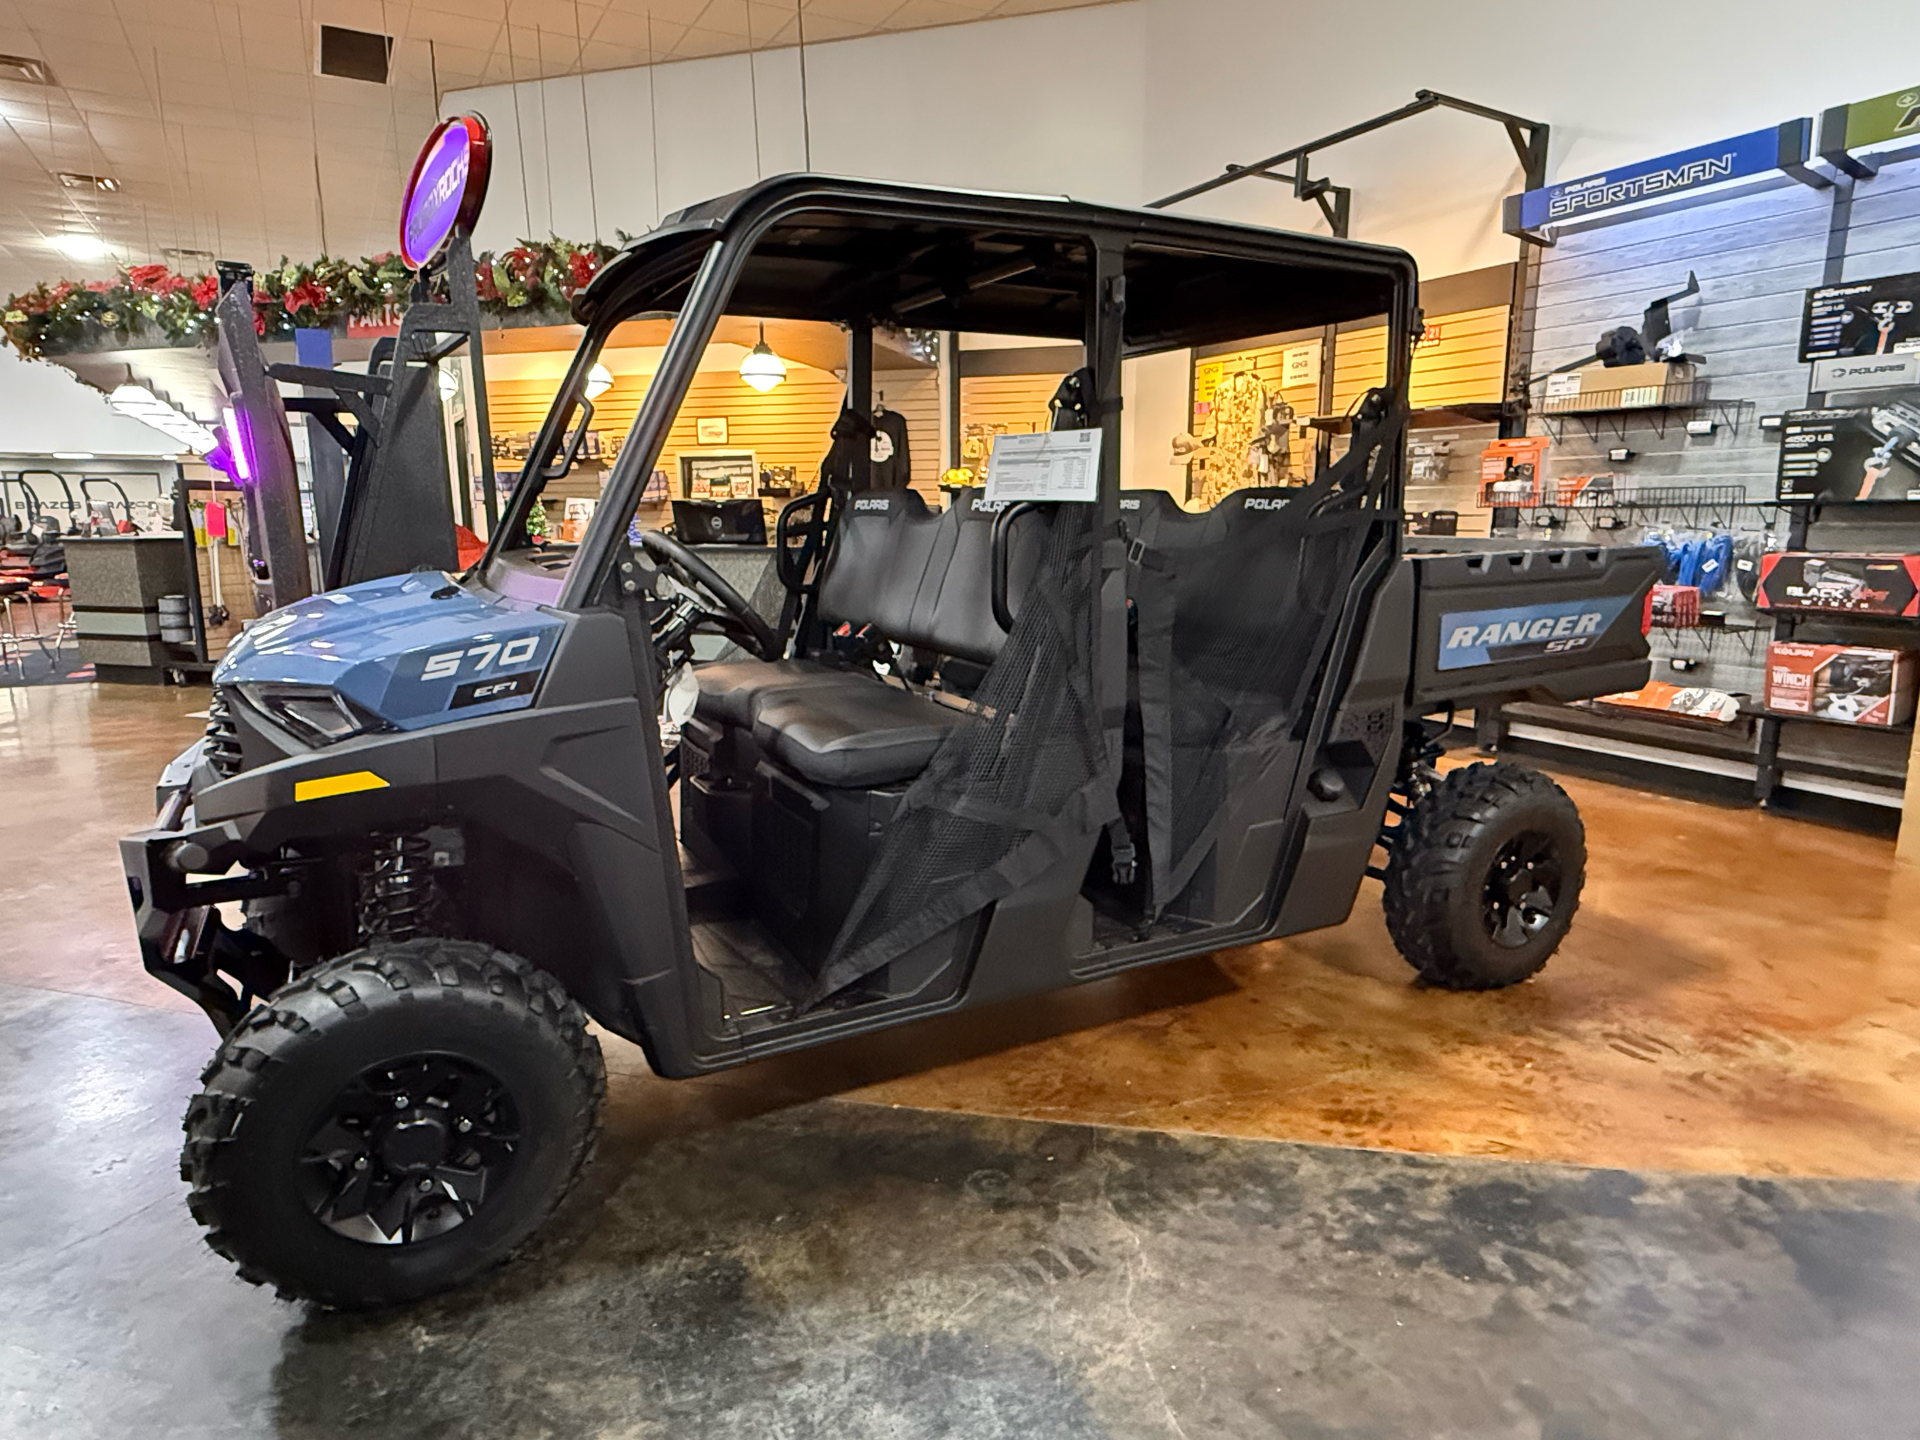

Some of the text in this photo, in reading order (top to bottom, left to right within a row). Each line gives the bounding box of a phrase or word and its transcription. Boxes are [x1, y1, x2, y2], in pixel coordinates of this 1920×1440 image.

[1550, 153, 1731, 218] SPORTSMAN
[1849, 363, 1906, 376] POLARIS
[854, 500, 890, 511] POLARIS
[1786, 586, 1844, 599] BLACK
[1446, 613, 1602, 649] RANGER
[1544, 637, 1587, 653] SP
[421, 636, 540, 681] 570
[1772, 671, 1811, 687] WINCH
[473, 681, 518, 698] EFI
